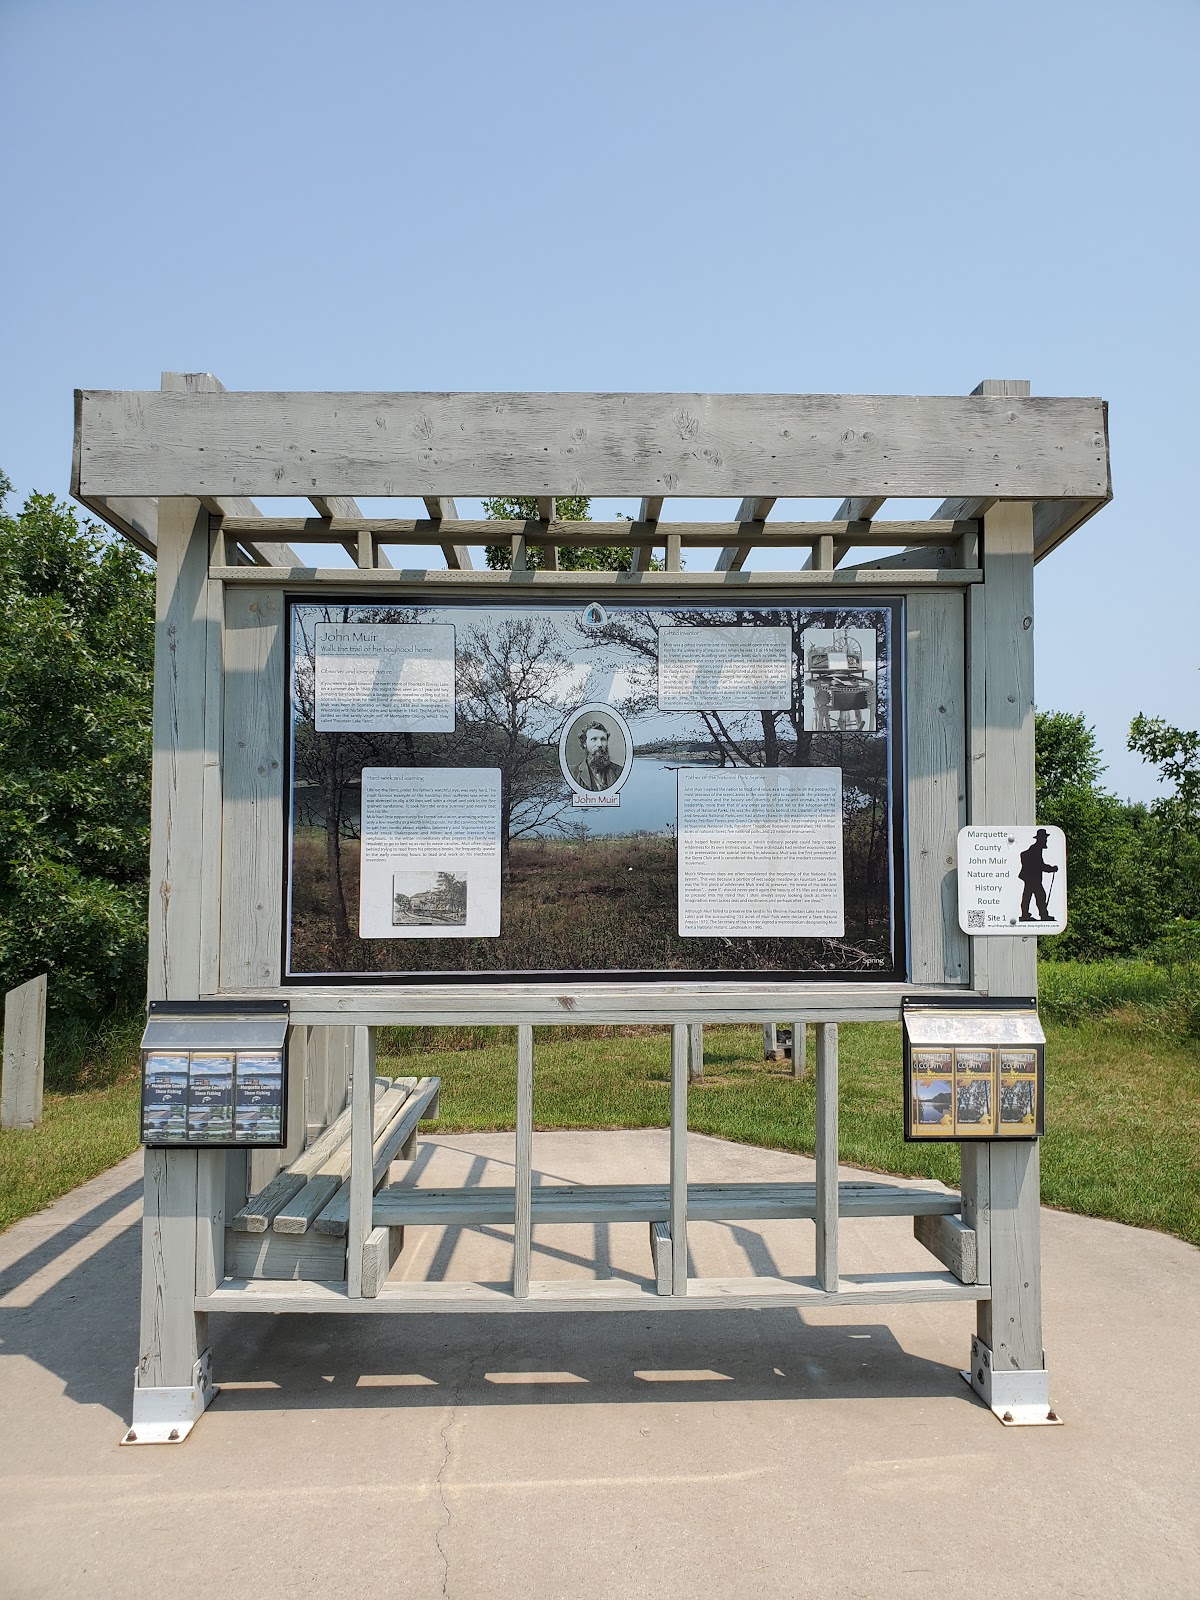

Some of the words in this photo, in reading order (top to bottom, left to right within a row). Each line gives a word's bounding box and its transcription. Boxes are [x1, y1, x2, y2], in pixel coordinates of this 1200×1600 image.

[320, 629, 350, 642] John
[353, 632, 378, 642] Muir
[364, 644, 372, 652] of
[384, 645, 414, 655] boyhood
[575, 794, 596, 803] John
[967, 831, 1008, 840] Marquette
[974, 844, 1002, 853] County
[976, 884, 1002, 893] History
[862, 957, 885, 966] Spring
